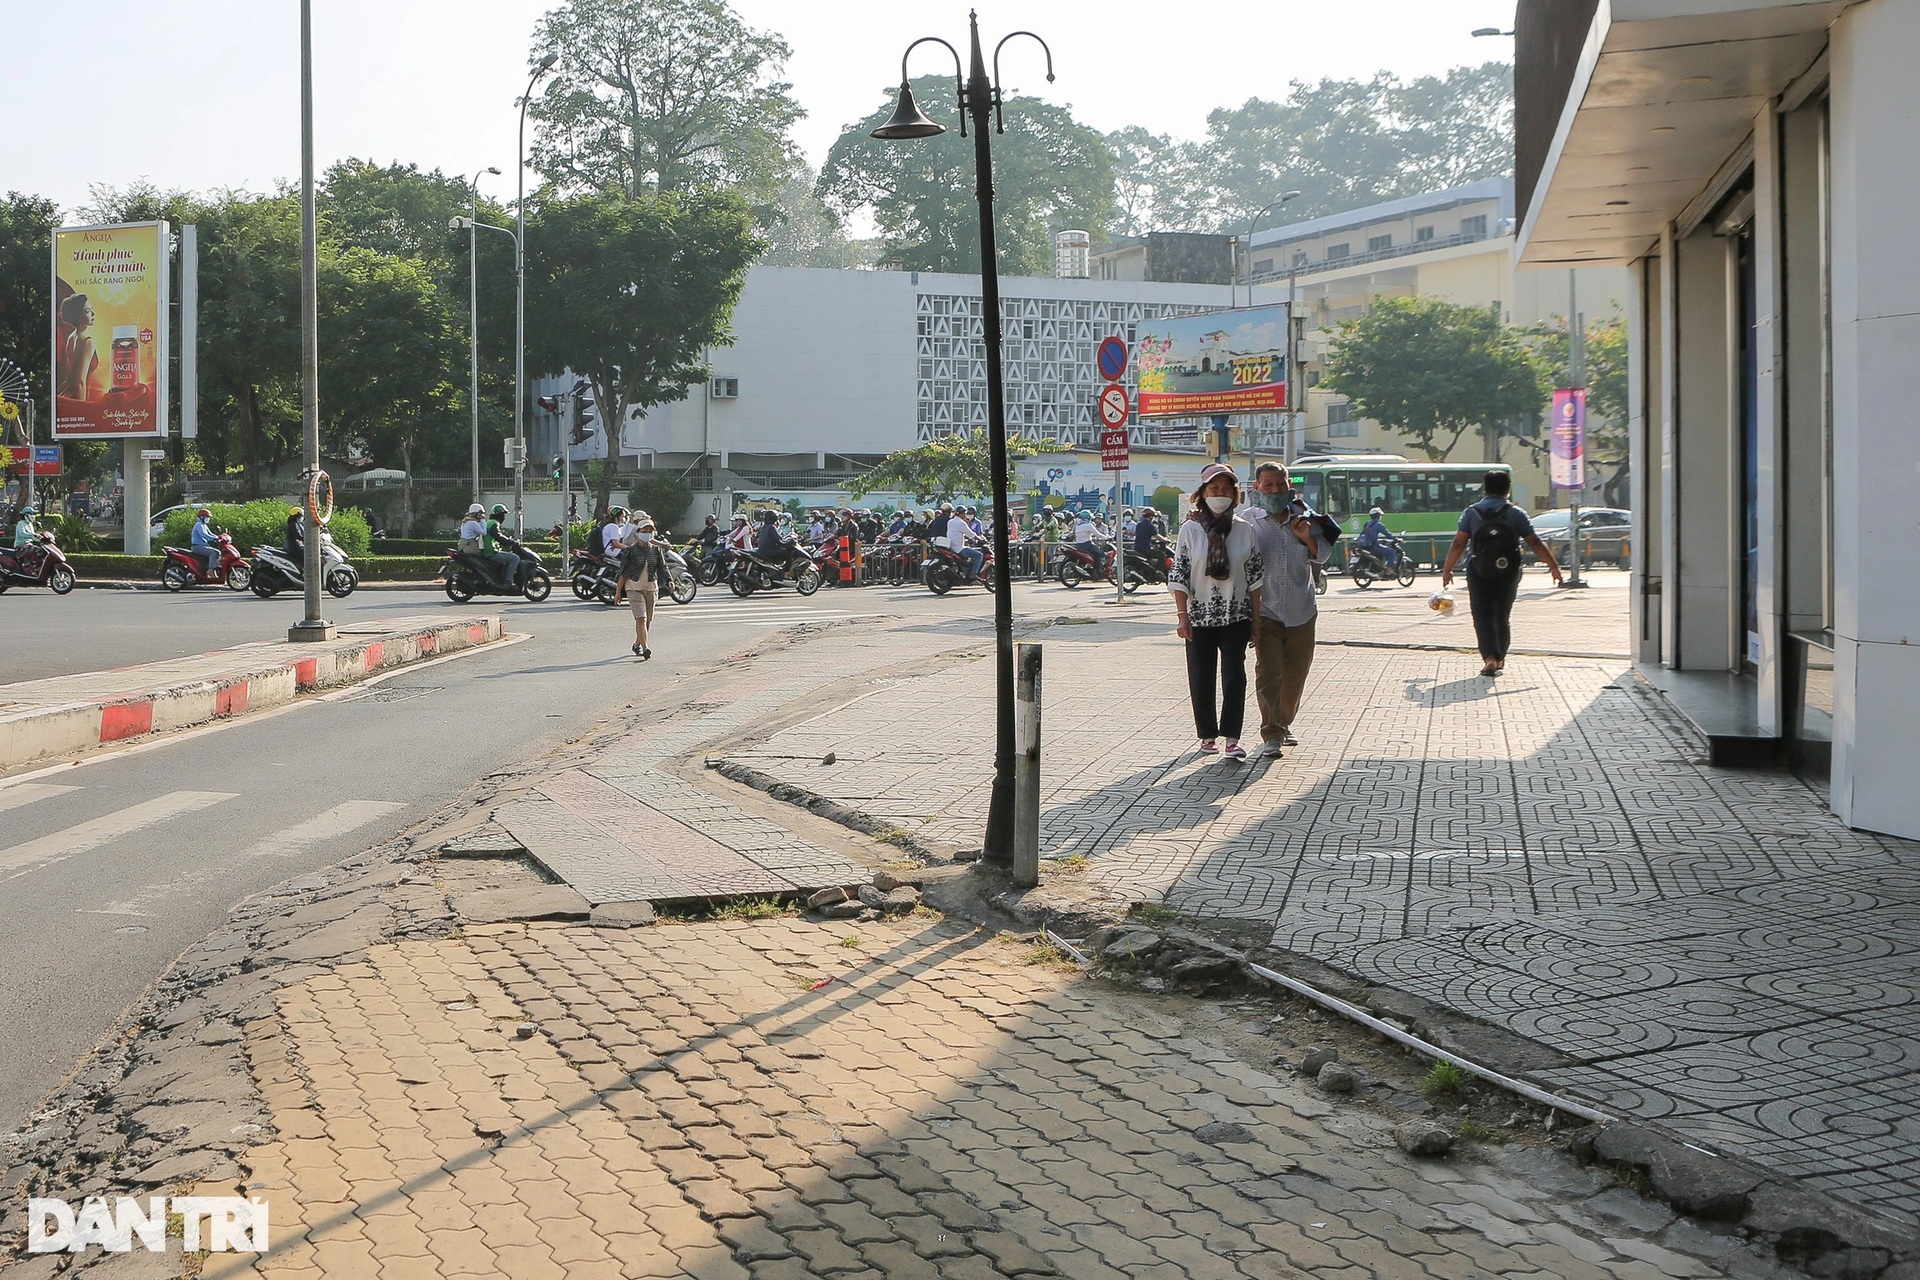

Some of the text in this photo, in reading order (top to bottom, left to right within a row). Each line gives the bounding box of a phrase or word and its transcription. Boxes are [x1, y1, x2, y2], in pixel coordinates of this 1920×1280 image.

[82, 232, 113, 243] ANGELA
[72, 248, 134, 263] Hạnh phúc
[1232, 365, 1272, 385] 2022
[1106, 433, 1123, 446] CẤM
